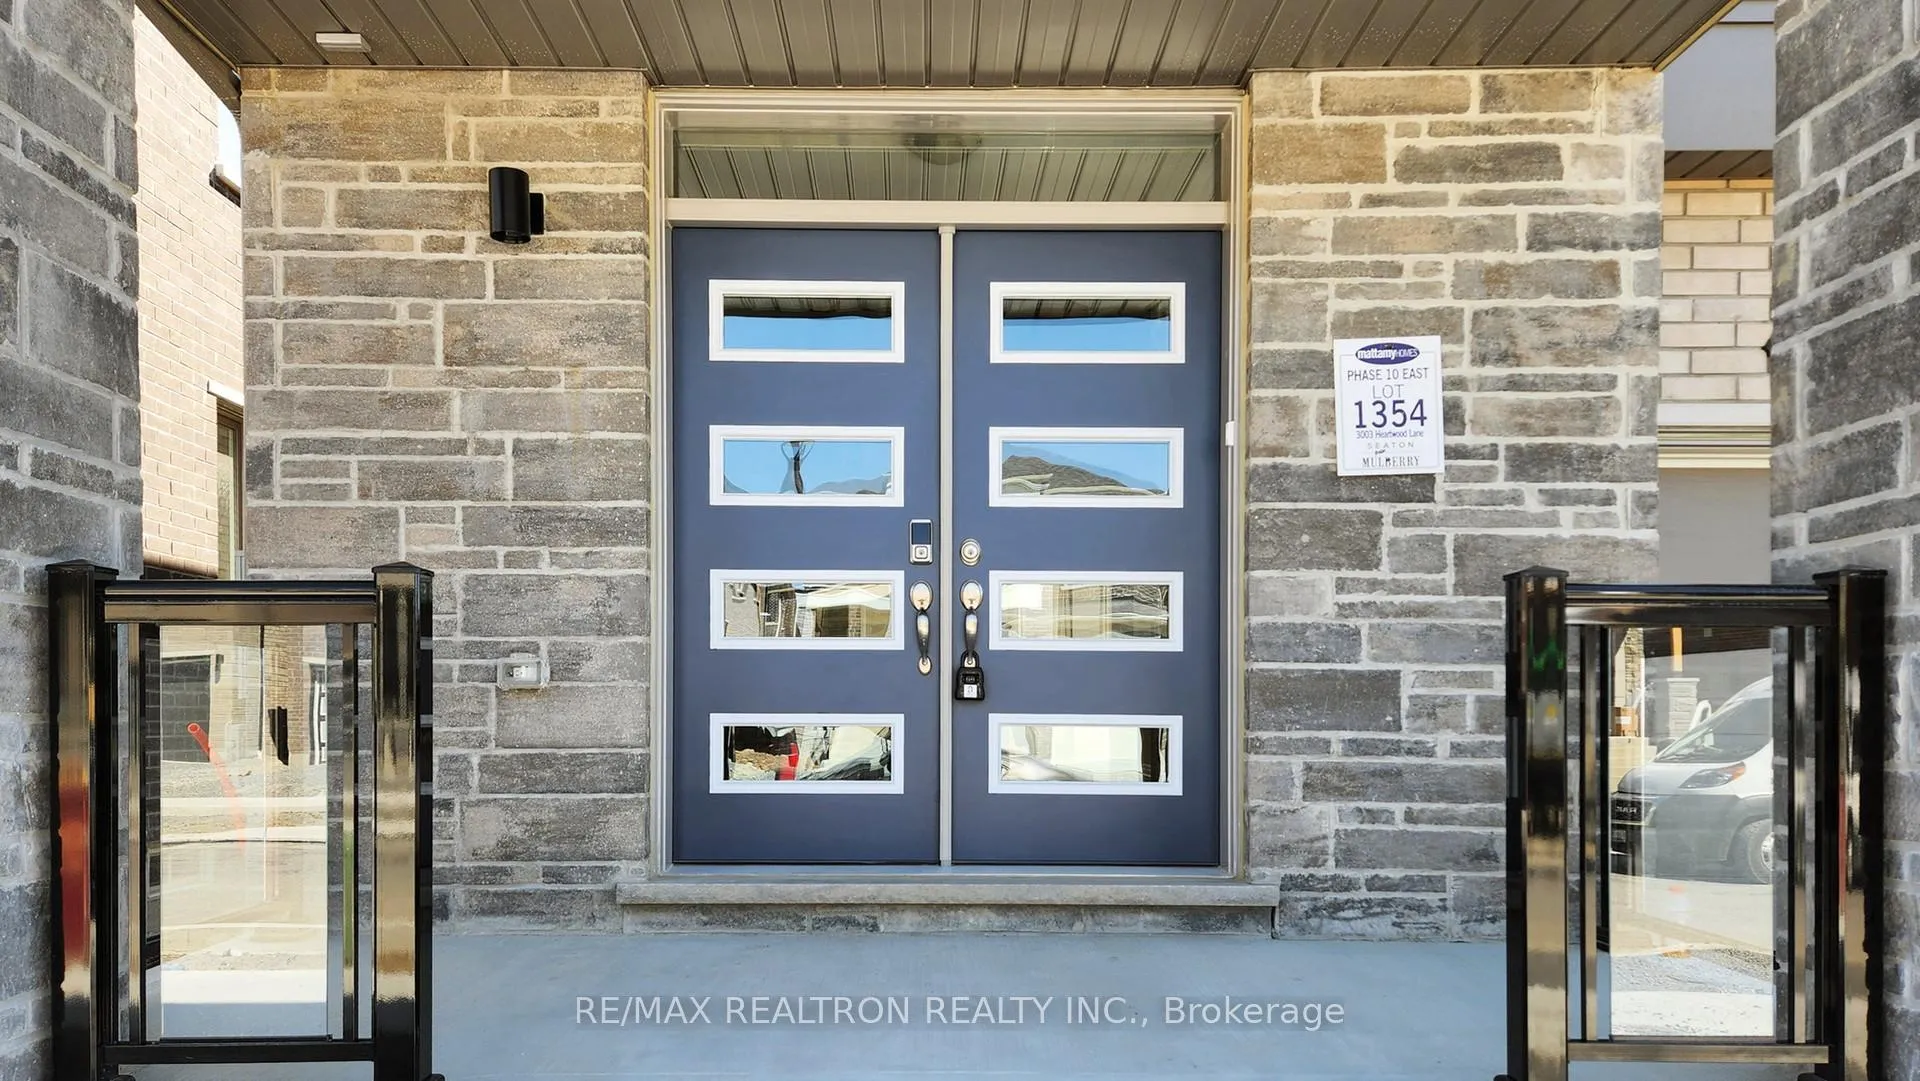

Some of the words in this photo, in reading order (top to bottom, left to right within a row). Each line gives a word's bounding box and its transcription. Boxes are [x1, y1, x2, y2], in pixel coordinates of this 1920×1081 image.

[1347, 369, 1382, 381] PHASE
[1386, 368, 1399, 380] 10
[1402, 367, 1428, 379] EAST
[1372, 384, 1404, 399] LOT
[1354, 399, 1427, 428] 1354
[1356, 430, 1373, 439] 3003
[1409, 429, 1424, 438] Lane
[1362, 456, 1420, 468] MULBERRY
